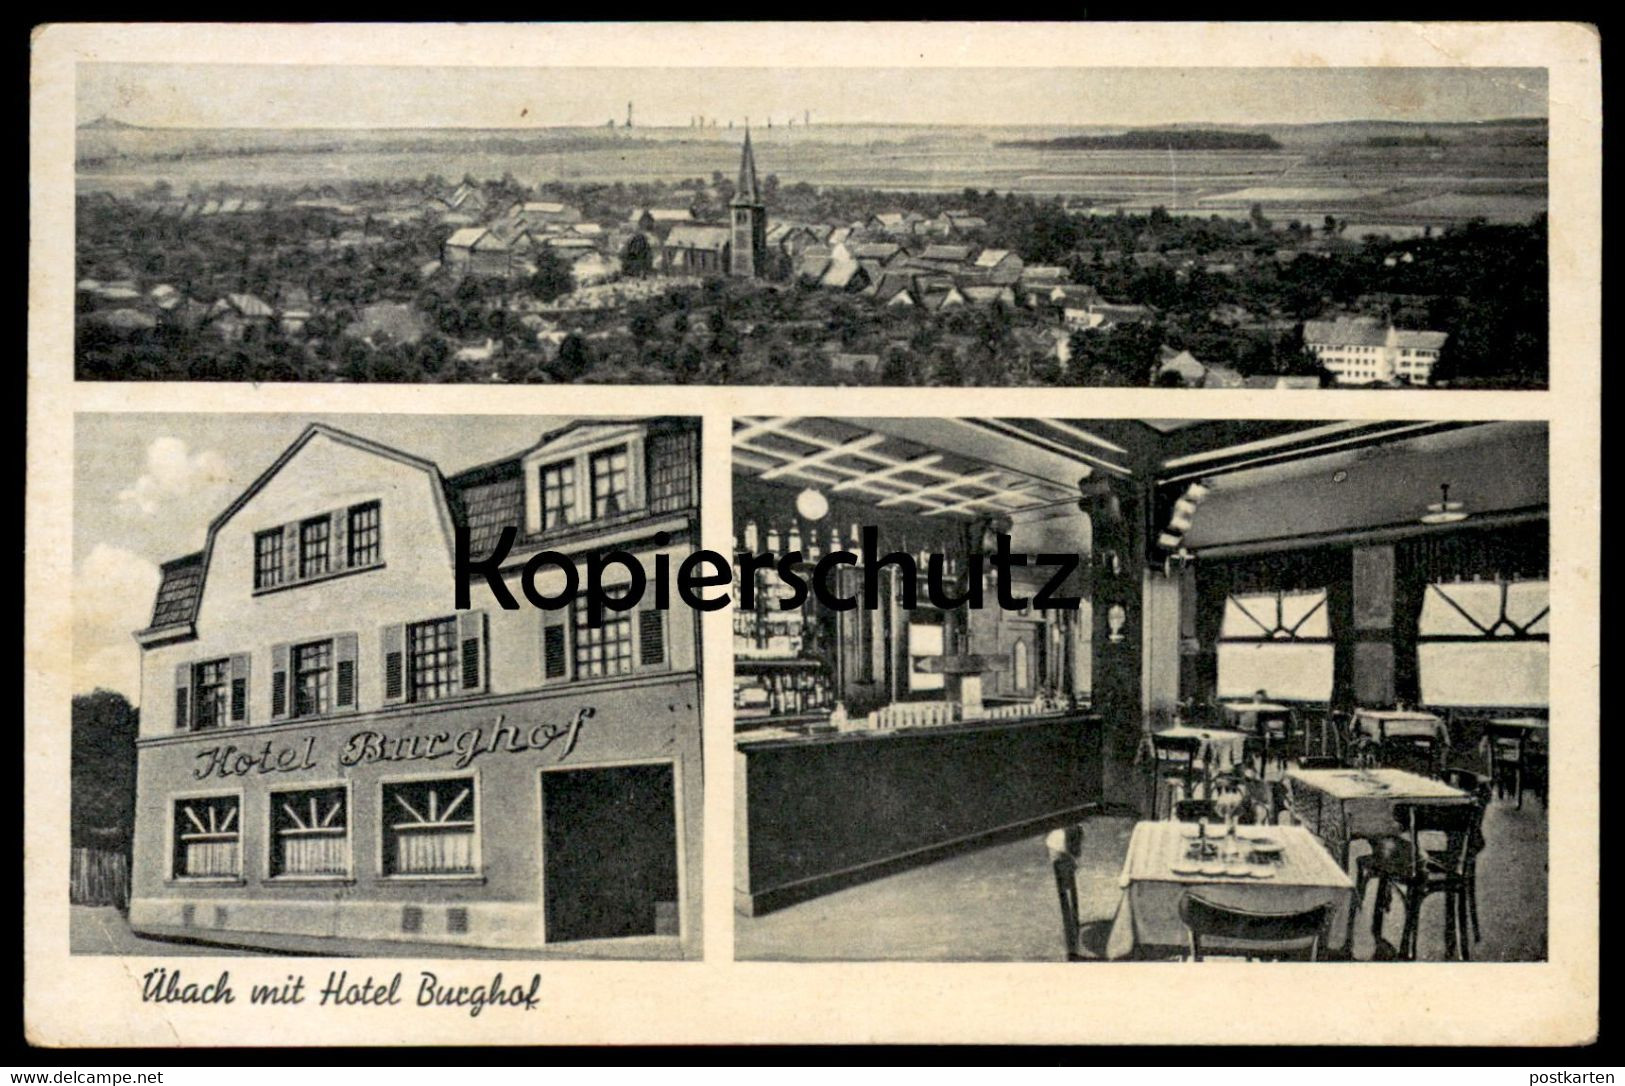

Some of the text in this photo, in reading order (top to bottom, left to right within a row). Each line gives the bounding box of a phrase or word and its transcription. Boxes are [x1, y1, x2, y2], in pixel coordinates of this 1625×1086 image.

[194, 706, 596, 780] Hotel Burghof
[143, 969, 540, 1016] Übach mit Hotel Burghof
